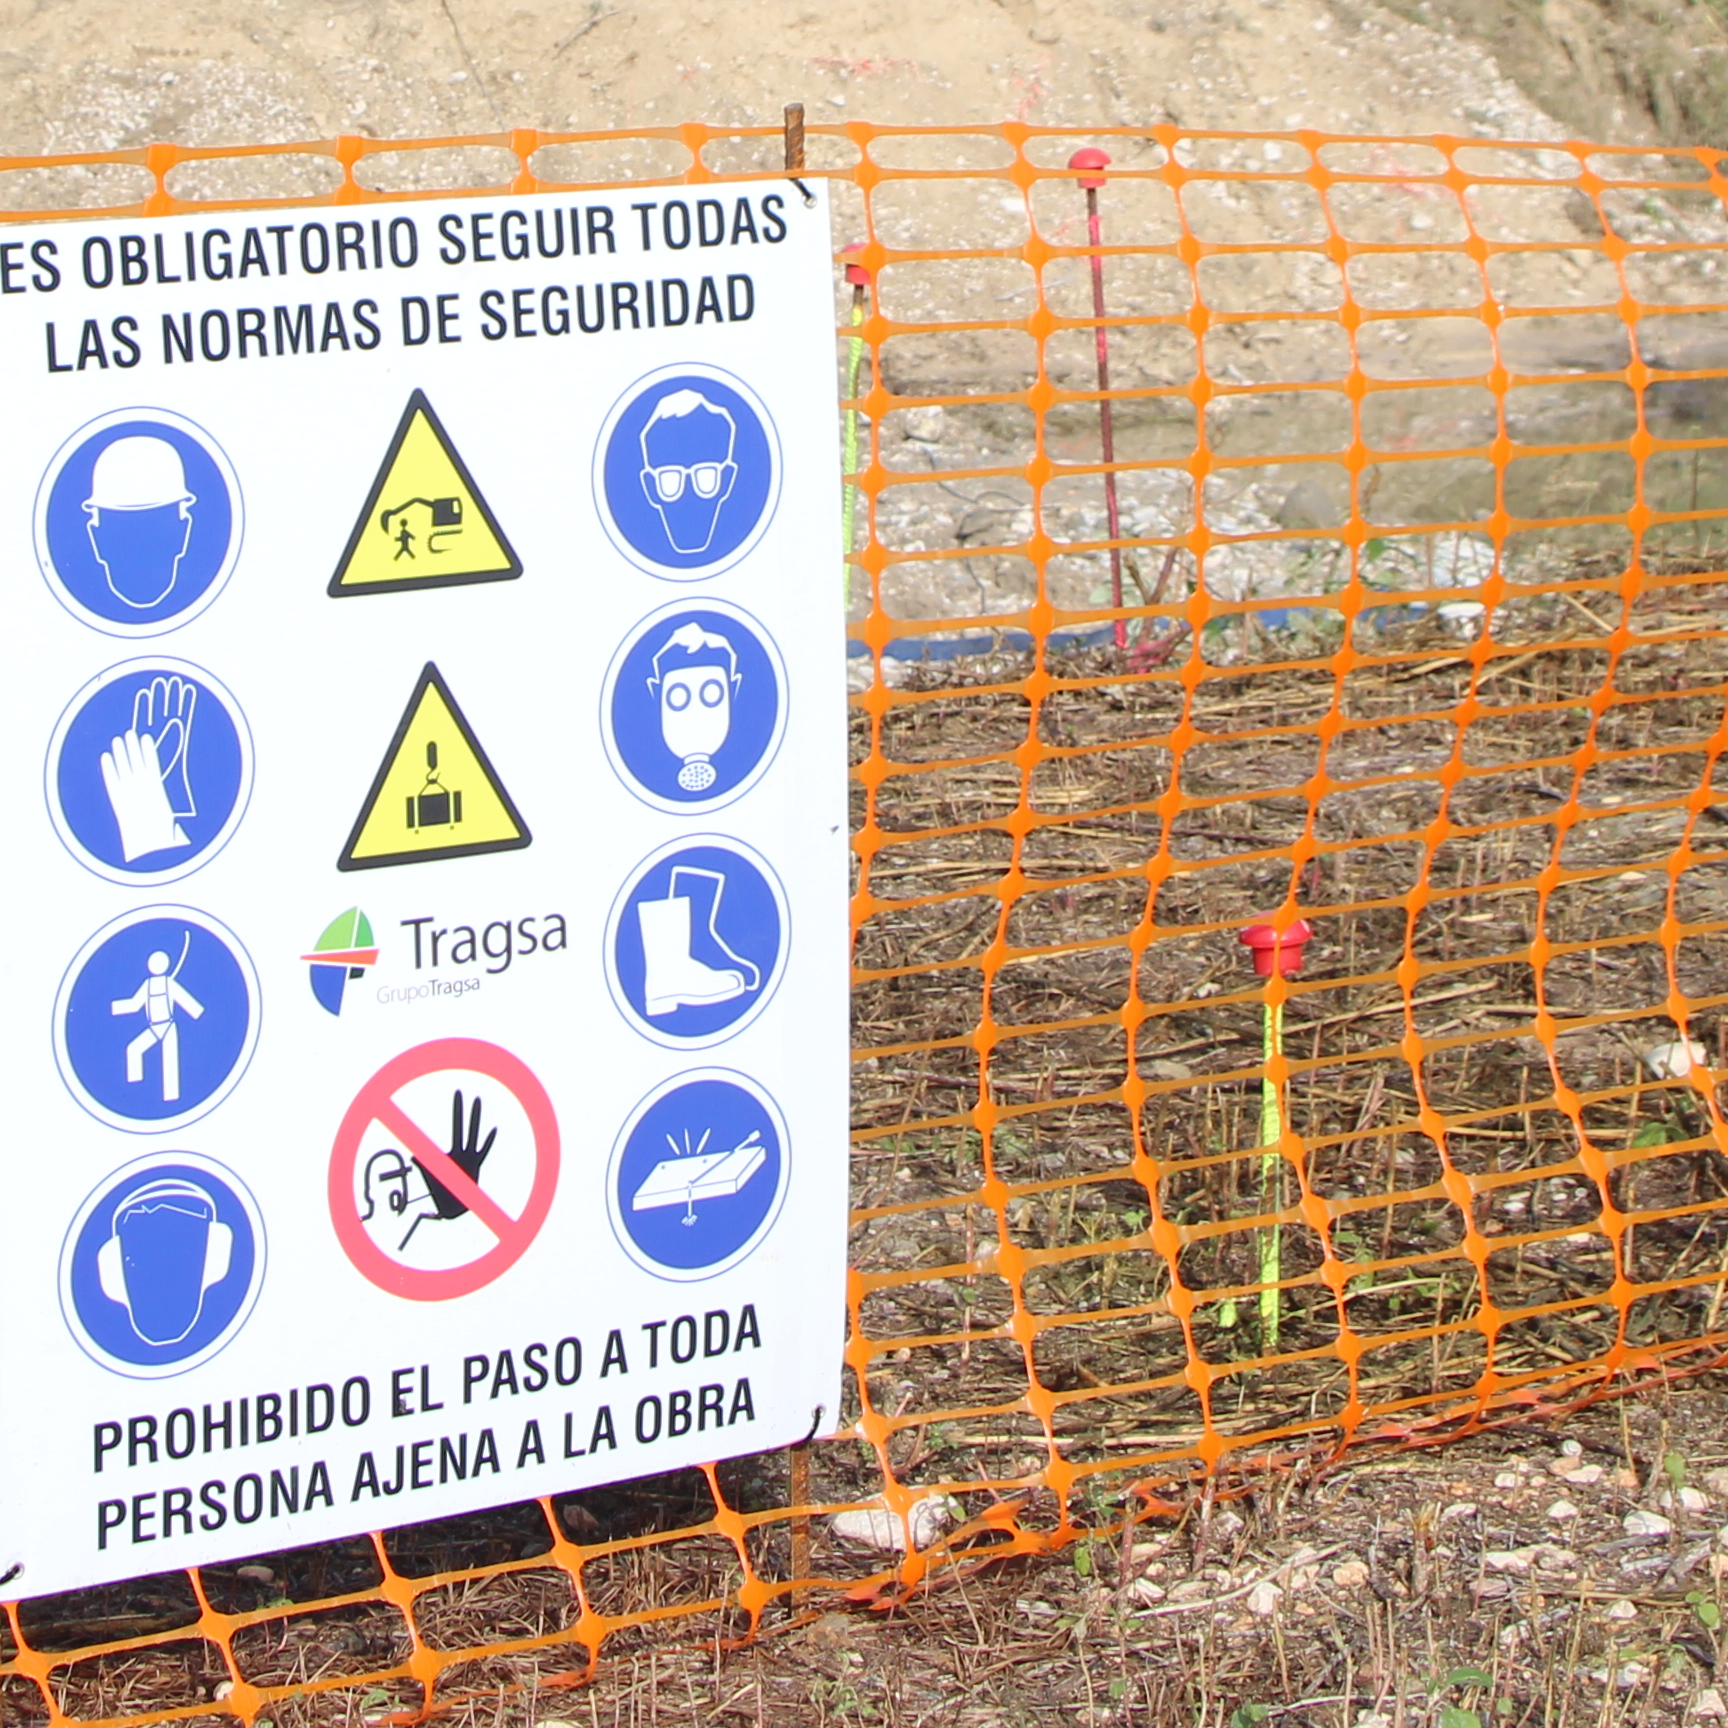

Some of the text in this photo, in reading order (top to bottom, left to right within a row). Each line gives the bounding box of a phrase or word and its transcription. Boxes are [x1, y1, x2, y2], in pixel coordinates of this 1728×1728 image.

[0, 195, 787, 294] ES OBLIGATORIO SEGUIR TODAS
[46, 274, 754, 373] LAS NORMAS DE SEGURIDAD
[376, 977, 481, 1004] GrupoTragsa
[400, 912, 568, 975] Tragsa
[94, 1304, 761, 1473] PROHIBIDO EL PASO A TODA
[98, 1377, 755, 1550] PERSONA AJENA A LA OBRA
